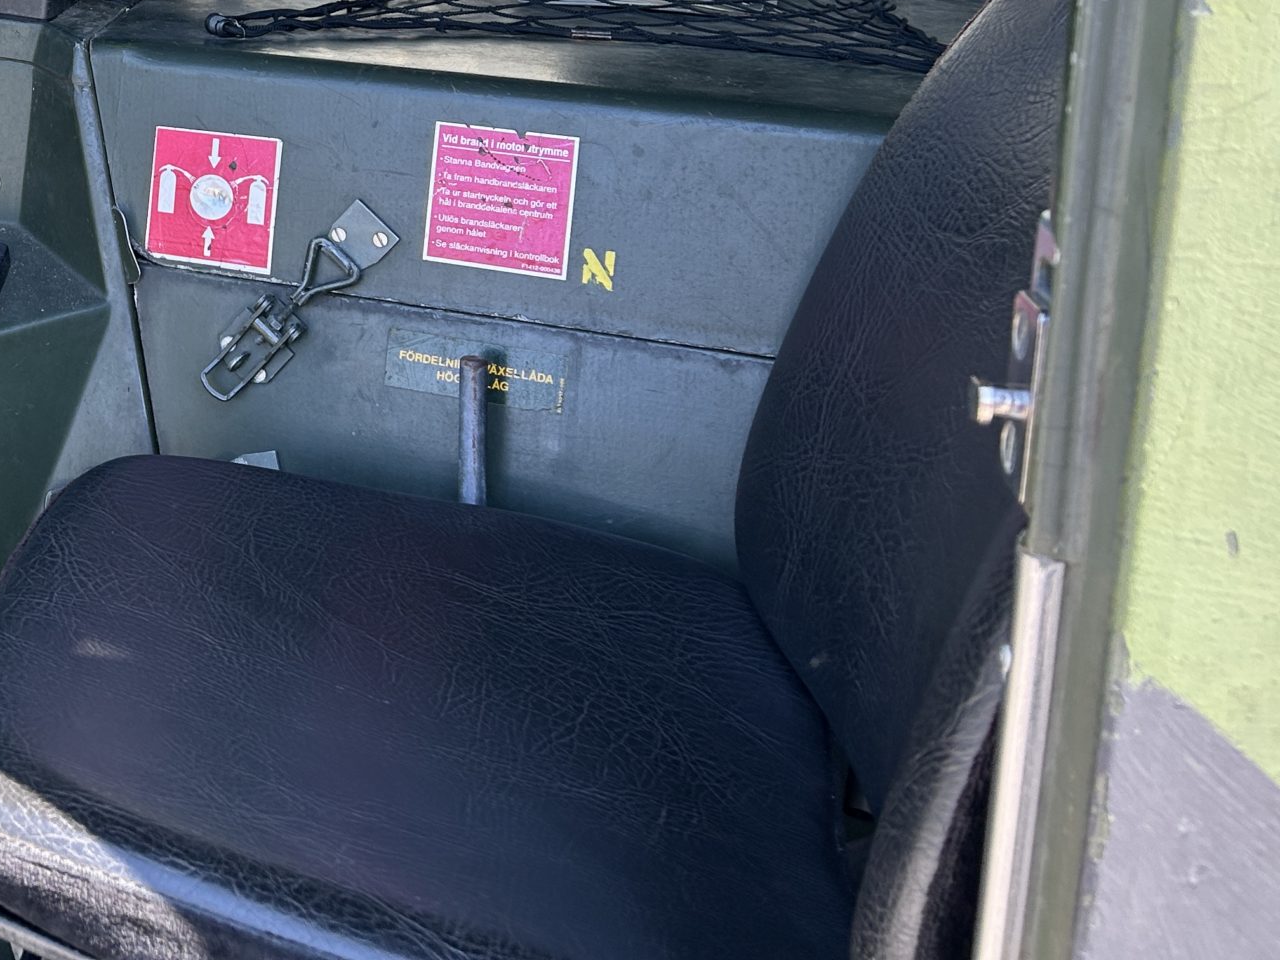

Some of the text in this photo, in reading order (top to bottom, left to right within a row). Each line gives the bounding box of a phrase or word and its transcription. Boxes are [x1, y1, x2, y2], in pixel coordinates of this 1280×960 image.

[442, 133, 458, 144] Vid
[491, 139, 494, 148] i
[444, 156, 526, 172] Stanna Bandvagnen
[443, 171, 557, 194] Ta fram handbrandsläckaren
[439, 197, 451, 206] hål
[519, 209, 553, 220] centrum
[441, 187, 451, 196] Ta
[463, 190, 511, 203] startnyckeln
[513, 197, 529, 206] och
[530, 199, 544, 210] gör
[546, 202, 558, 210] ett
[436, 225, 487, 238] genom hålet
[439, 214, 523, 232] Utlös brandsläckaren
[449, 241, 508, 258] släckanvisning
[514, 250, 559, 264] kontrollbok
